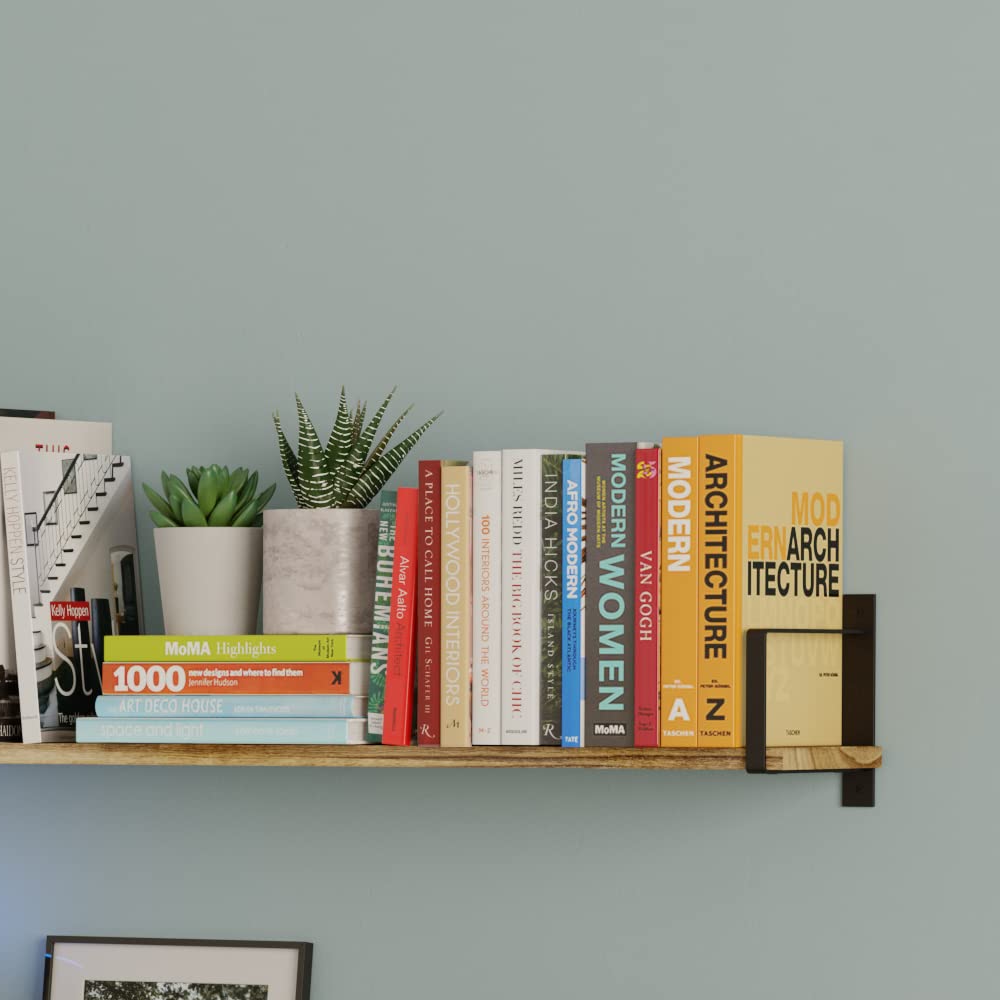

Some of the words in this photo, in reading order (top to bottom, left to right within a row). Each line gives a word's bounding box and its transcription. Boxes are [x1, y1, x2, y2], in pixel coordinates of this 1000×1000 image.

[3, 466, 17, 503] KELLY
[424, 469, 433, 478] A
[512, 459, 523, 502] MILES
[424, 482, 433, 523] PLACE
[544, 473, 558, 530] INDIA
[566, 479, 578, 525] AFRO
[610, 453, 626, 548] MODERN
[667, 456, 692, 572] MODERN
[791, 491, 841, 527] MOD
[5, 507, 21, 554] HOPPEN
[378, 520, 389, 542] NEW
[424, 526, 433, 546] TO
[480, 514, 490, 535] 100
[512, 506, 523, 545] REDD
[445, 484, 460, 606] HOLLYWOOD
[704, 453, 728, 659] ARCHITECTURE
[10, 557, 26, 594] STYLE
[398, 555, 410, 585] Alvar
[424, 549, 433, 583] CALL
[480, 538, 490, 592] INTERIORS
[512, 552, 523, 581] THE
[544, 537, 558, 601] HICKS
[566, 528, 578, 599] MODERN
[640, 550, 652, 585] VAN
[748, 561, 840, 597] ITECTURE
[51, 603, 66, 619] Kelly
[67, 604, 90, 619] Hoppen
[396, 588, 408, 620] Aalto
[424, 587, 433, 628] HOME
[512, 584, 523, 609] BIG
[480, 595, 490, 642] AROUND
[512, 612, 523, 653] BOOK
[598, 553, 626, 711] WOMEN
[640, 591, 652, 641] GOGH
[165, 641, 211, 657] MoMA
[216, 641, 277, 659] Highlights
[445, 611, 460, 706] INTERIORS
[480, 646, 490, 664] THE
[512, 657, 523, 677] OF
[113, 665, 187, 693] 1000
[188, 669, 203, 677] new
[203, 667, 229, 679] designs
[230, 667, 242, 677] and
[243, 667, 264, 677] where
[264, 668, 272, 677] to
[272, 667, 286, 677] find
[286, 667, 303, 677] them
[188, 678, 213, 688] Jennifer
[214, 678, 239, 687] Hudson
[480, 668, 490, 707] WORLD
[119, 698, 142, 713] ART
[144, 698, 178, 713] DECO
[181, 698, 223, 713] HOUSE
[667, 697, 691, 721] A
[594, 724, 626, 735] MoMA
[663, 729, 695, 737] TASCHEN
